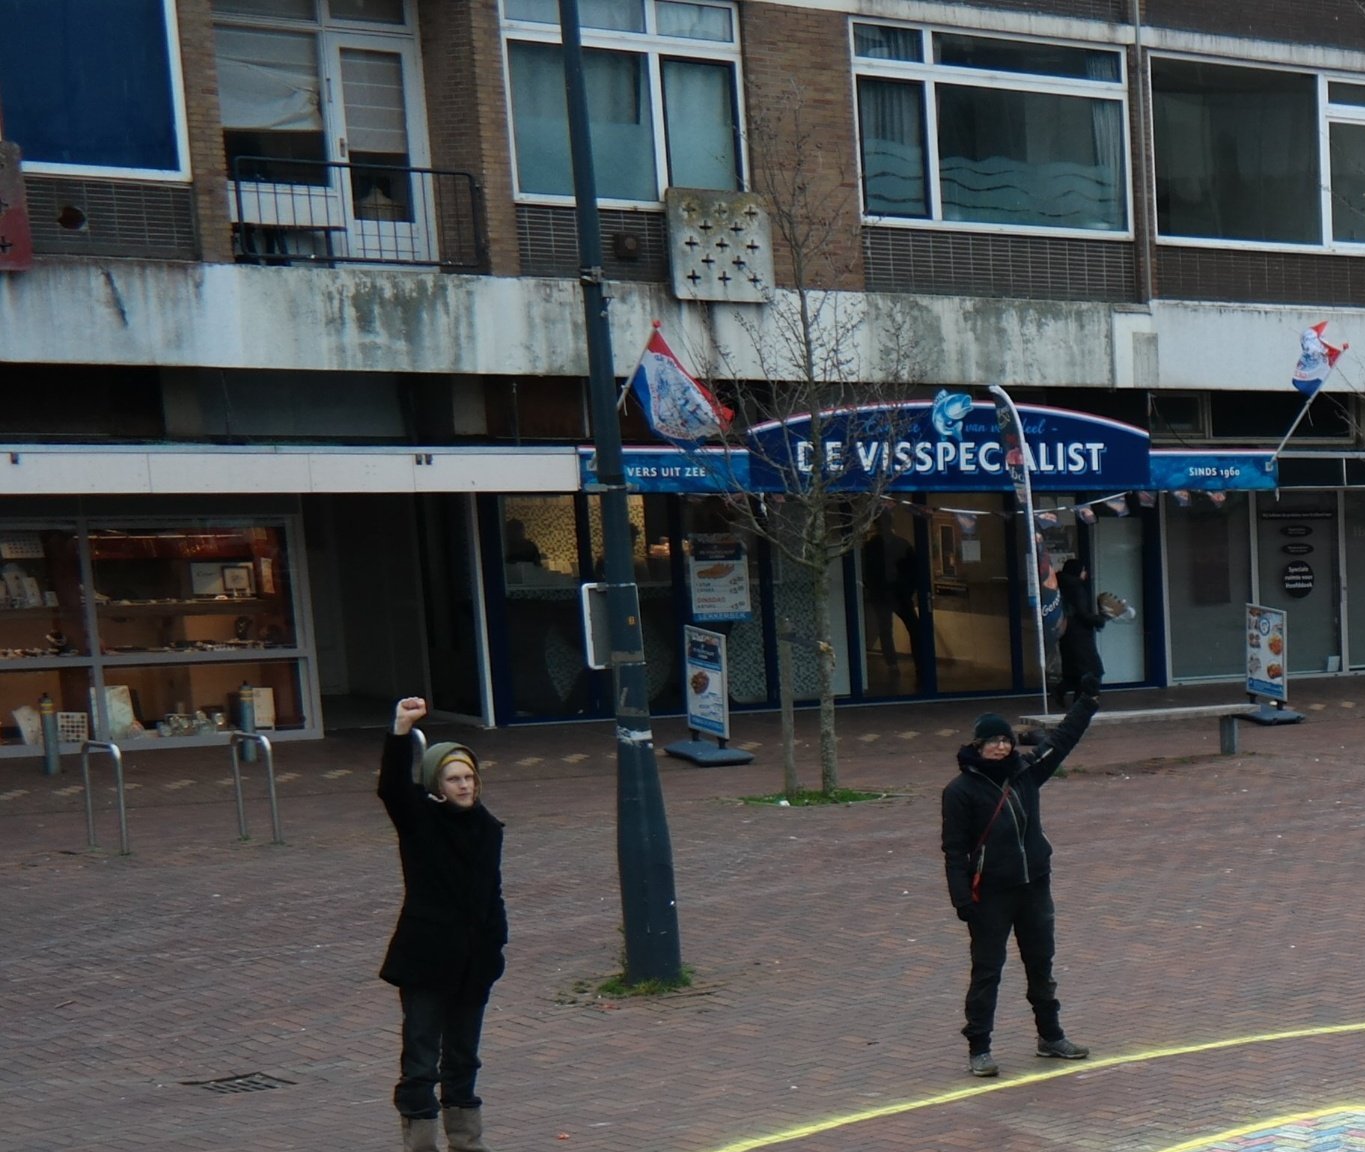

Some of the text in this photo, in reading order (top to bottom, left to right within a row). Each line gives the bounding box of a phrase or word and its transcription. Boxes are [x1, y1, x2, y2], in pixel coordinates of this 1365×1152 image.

[797, 441, 1105, 474] DE VISSPECALIST
[627, 467, 707, 477] VERS UIT ZEE
[1189, 467, 1240, 479] SINDS 1960
